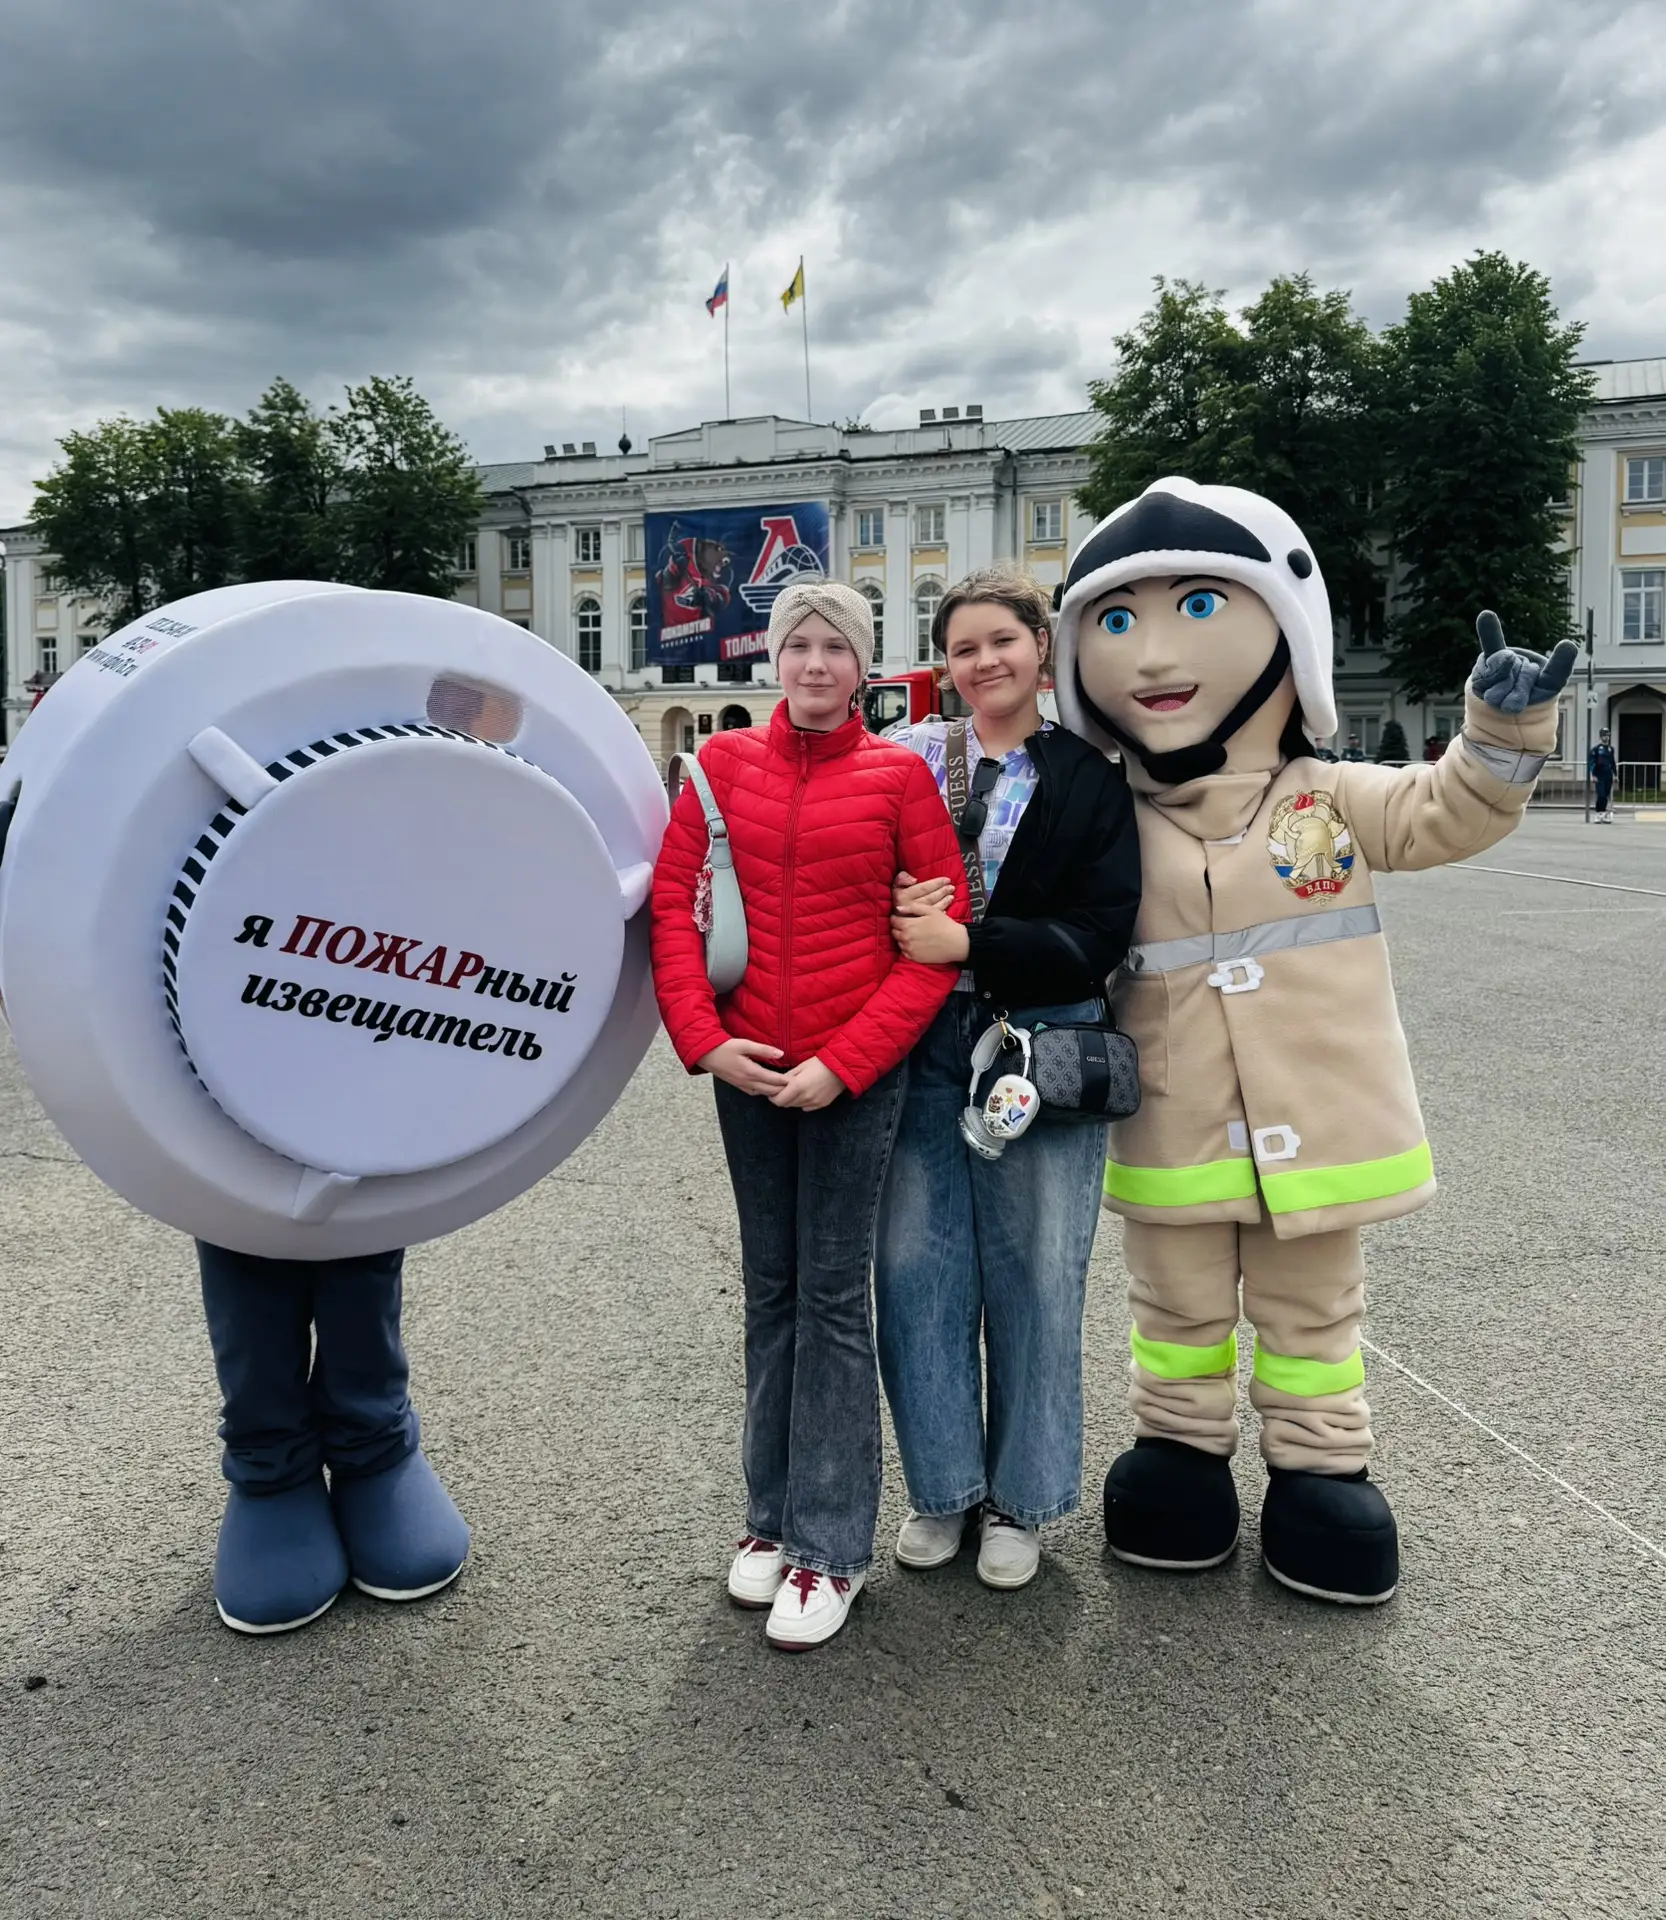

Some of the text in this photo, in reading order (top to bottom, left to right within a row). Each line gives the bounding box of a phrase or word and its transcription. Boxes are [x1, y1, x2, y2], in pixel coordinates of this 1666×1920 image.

[948, 755, 967, 826] GUESS
[233, 914, 578, 1014] я ПОЖАРный
[240, 973, 543, 1062] извещатель
[1086, 1055, 1106, 1064] GUESS
